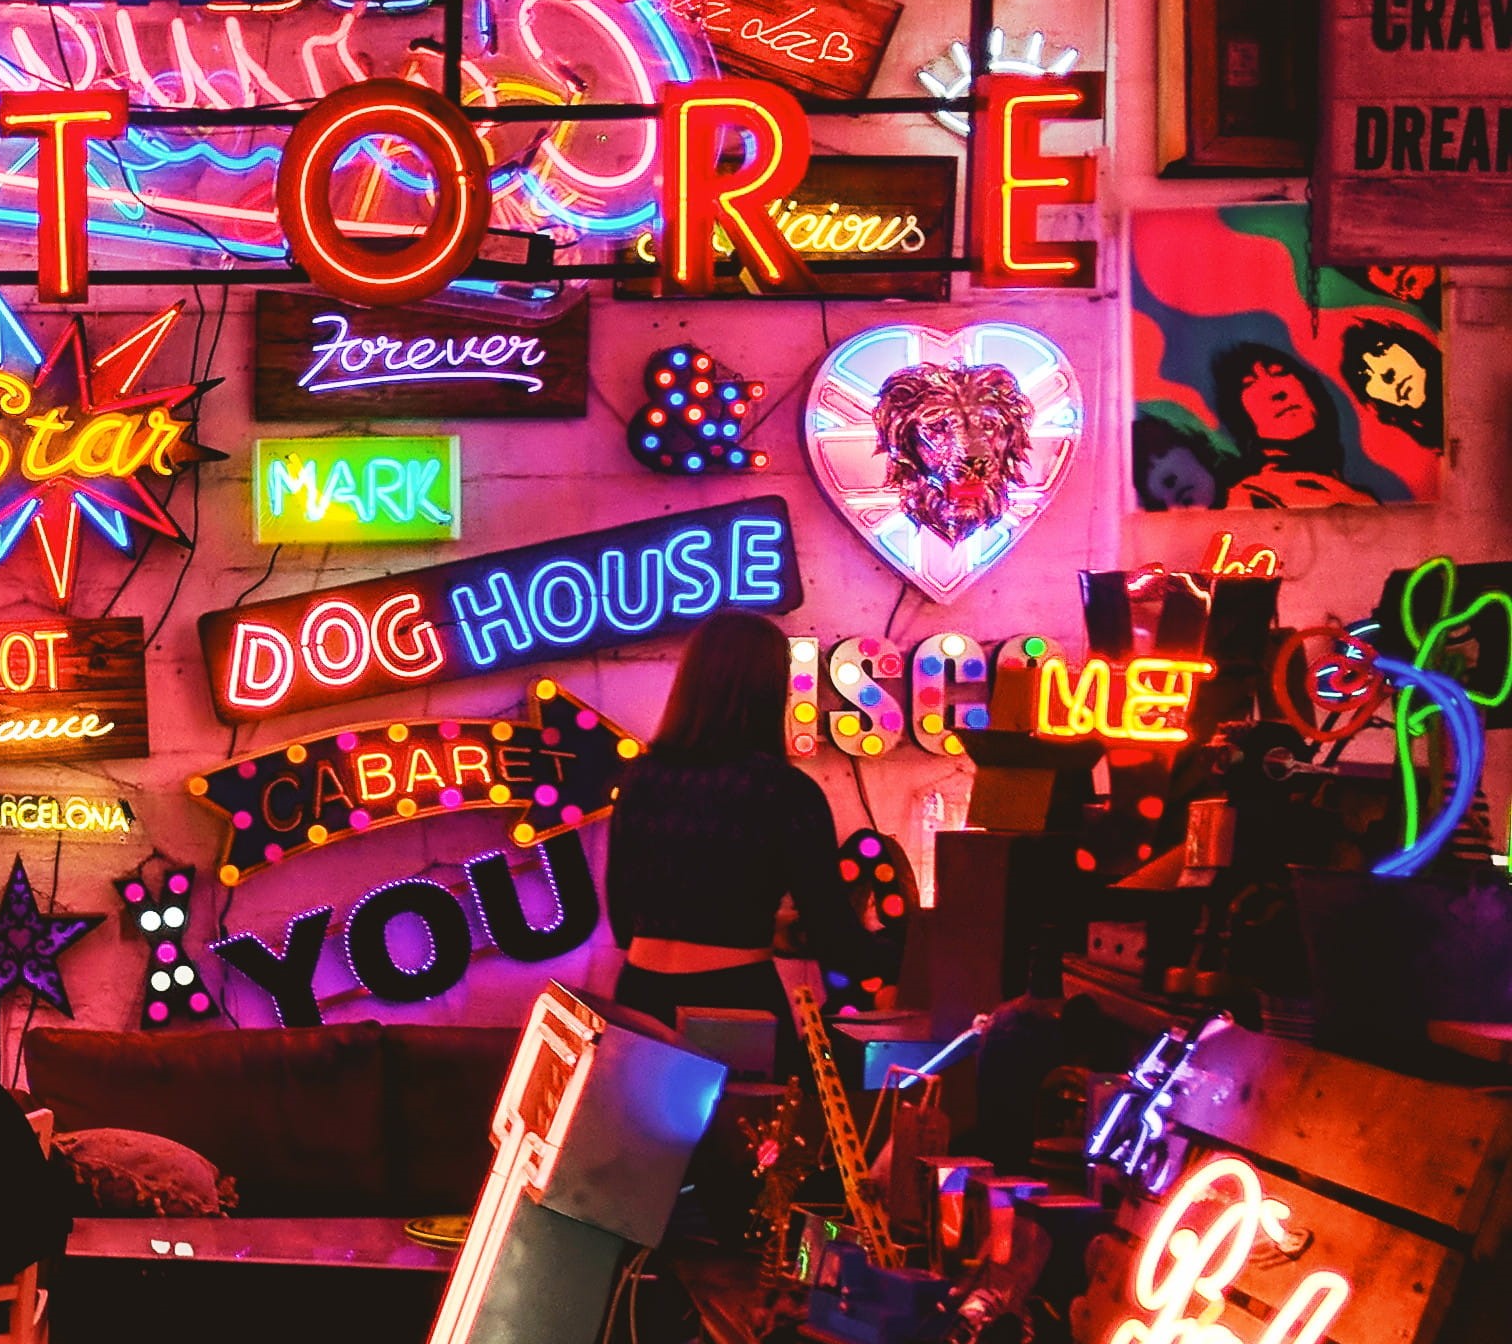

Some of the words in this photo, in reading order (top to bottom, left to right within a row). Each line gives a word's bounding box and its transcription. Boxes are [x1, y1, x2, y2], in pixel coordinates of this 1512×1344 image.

[1355, 105, 1512, 173] DREA
[299, 313, 546, 393] Forever
[266, 453, 453, 524] MARK
[227, 592, 445, 708] DOG
[449, 520, 783, 667] HOUSE
[261, 744, 578, 833] CABARET
[207, 830, 600, 1026] YOU
